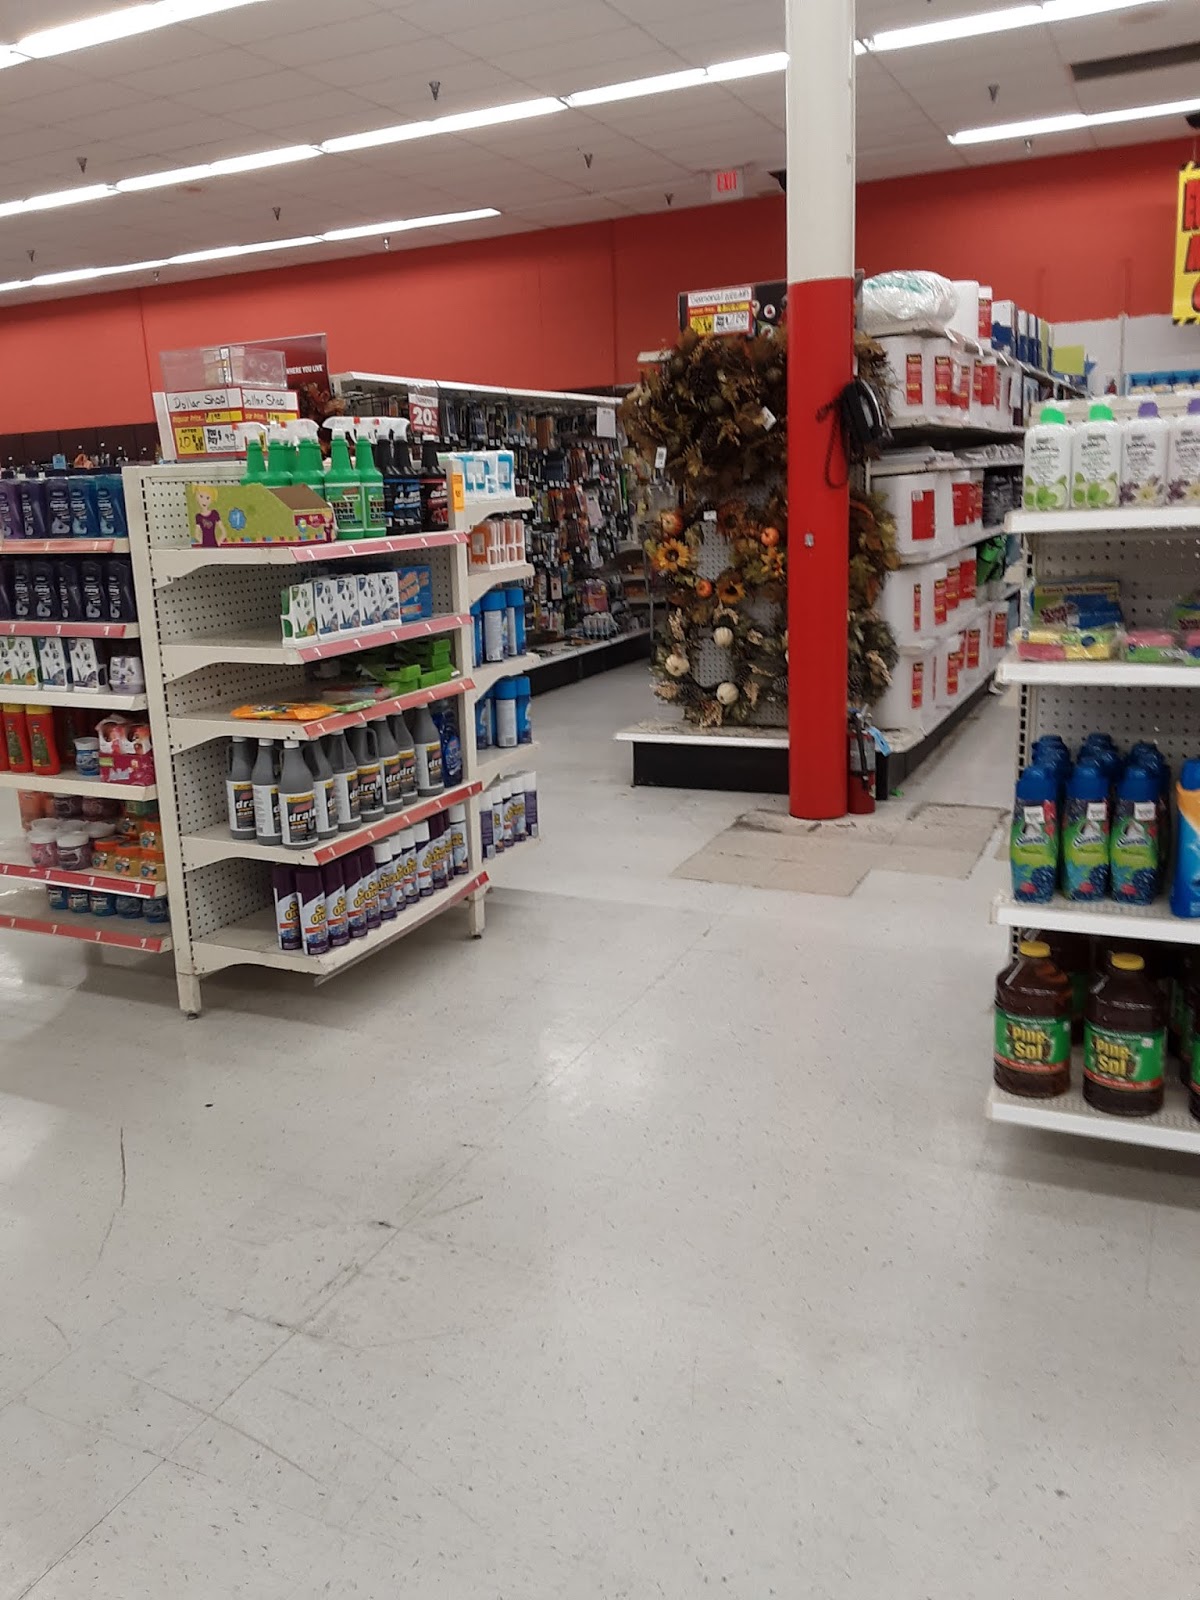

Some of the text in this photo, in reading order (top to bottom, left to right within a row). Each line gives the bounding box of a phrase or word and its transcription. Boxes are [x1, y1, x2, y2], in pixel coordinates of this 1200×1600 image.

[717, 170, 737, 192] EXIT
[302, 365, 312, 373] YOU
[312, 364, 323, 373] LIVE
[174, 396, 200, 409] Dollar
[412, 406, 432, 426] 20
[1014, 1041, 1043, 1060] Sol
[1097, 1054, 1127, 1076] Sol
